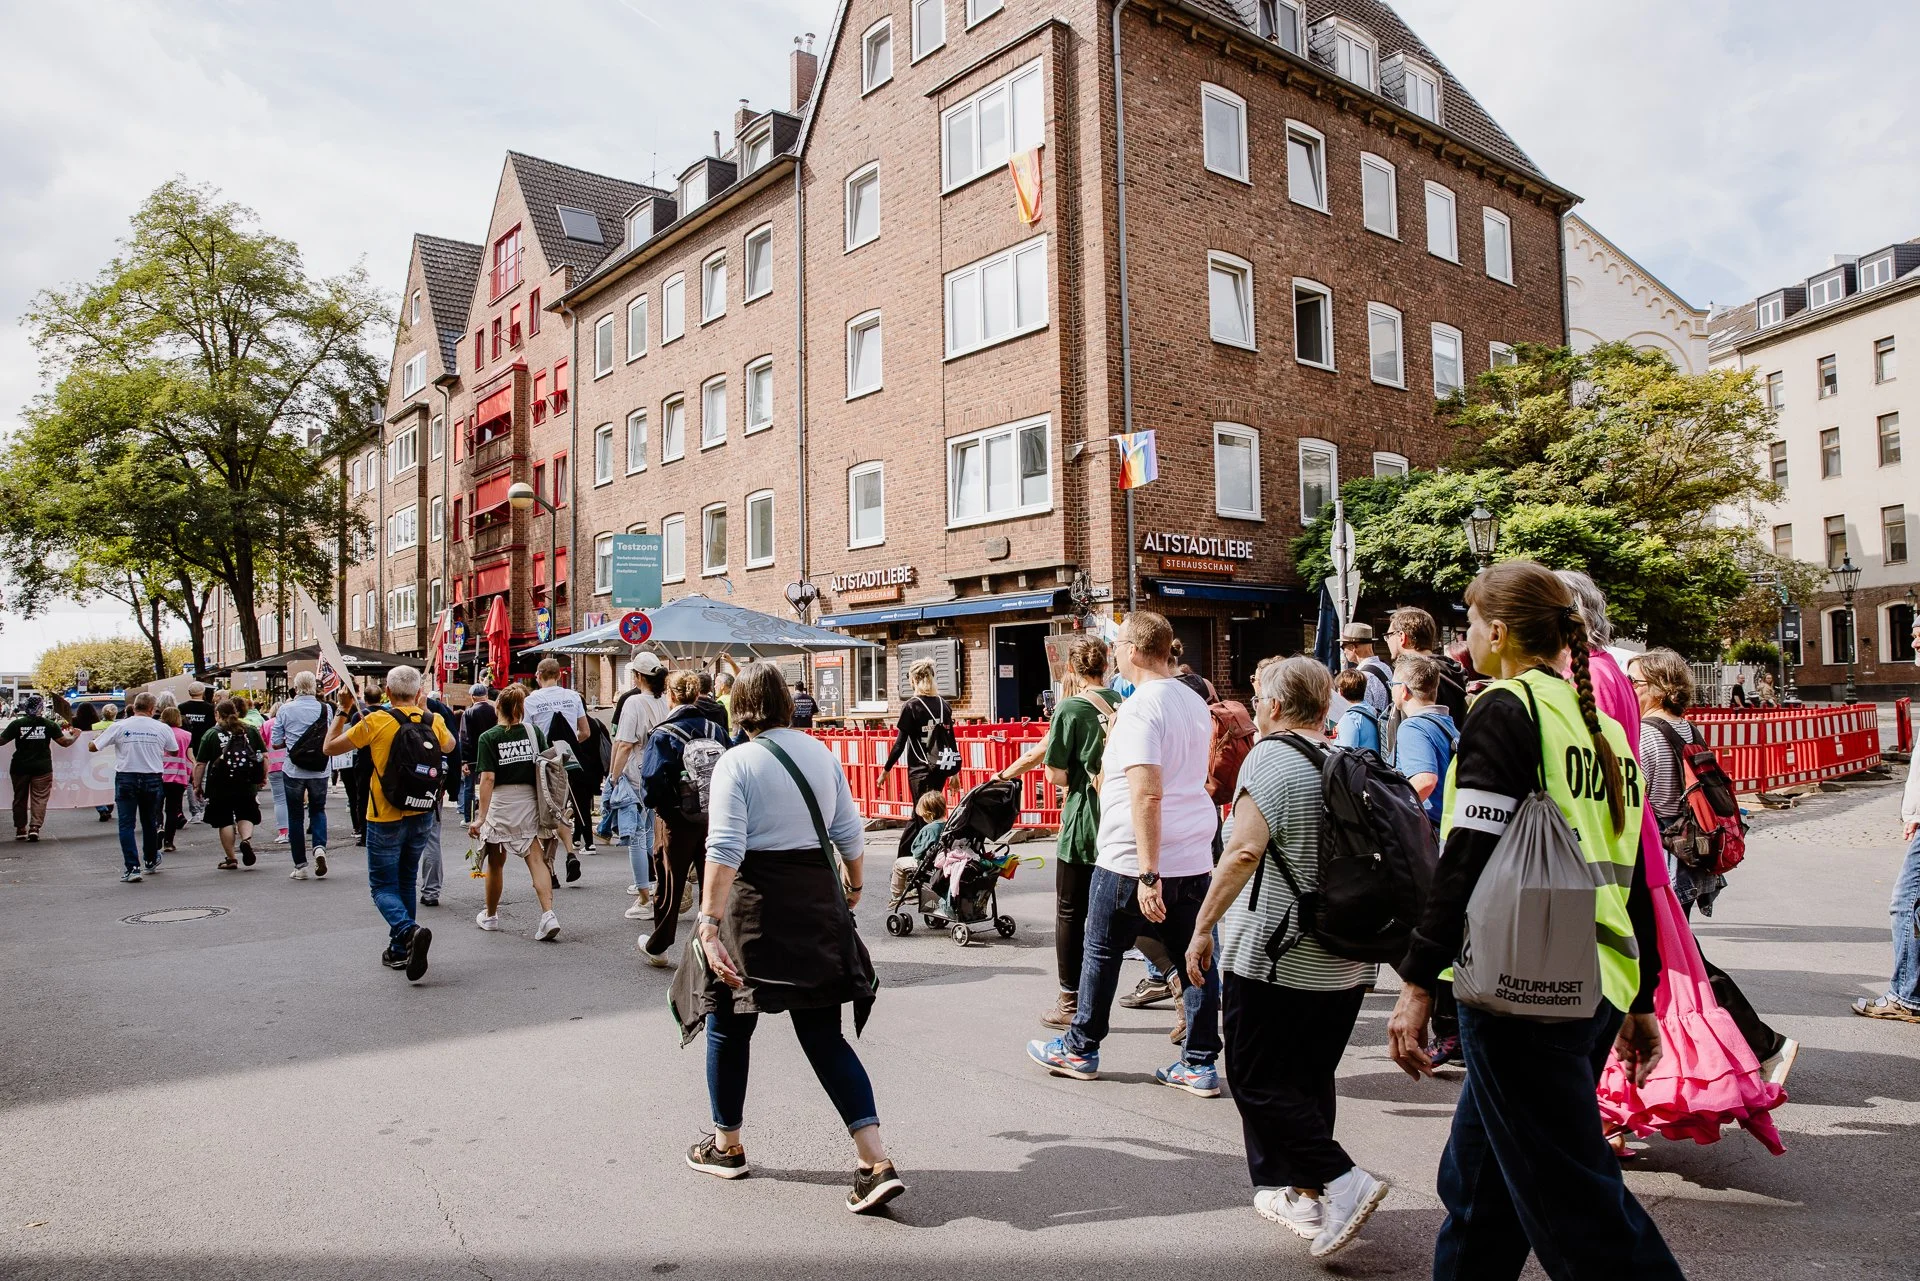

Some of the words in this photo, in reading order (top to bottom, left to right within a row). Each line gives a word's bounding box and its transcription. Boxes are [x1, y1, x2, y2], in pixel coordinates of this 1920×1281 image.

[616, 542, 659, 551] Testzone
[1144, 532, 1253, 559] ALTSTADTLIEBE
[1166, 559, 1234, 572] STEHAUSSCHANK
[830, 565, 912, 592] ALTSTADTLIEBE
[844, 590, 896, 602] STEHAUSSCHANK
[405, 796, 433, 808] PUMA
[1498, 973, 1583, 993] KULTURHUSET
[1495, 987, 1581, 1006] stadsteatern
